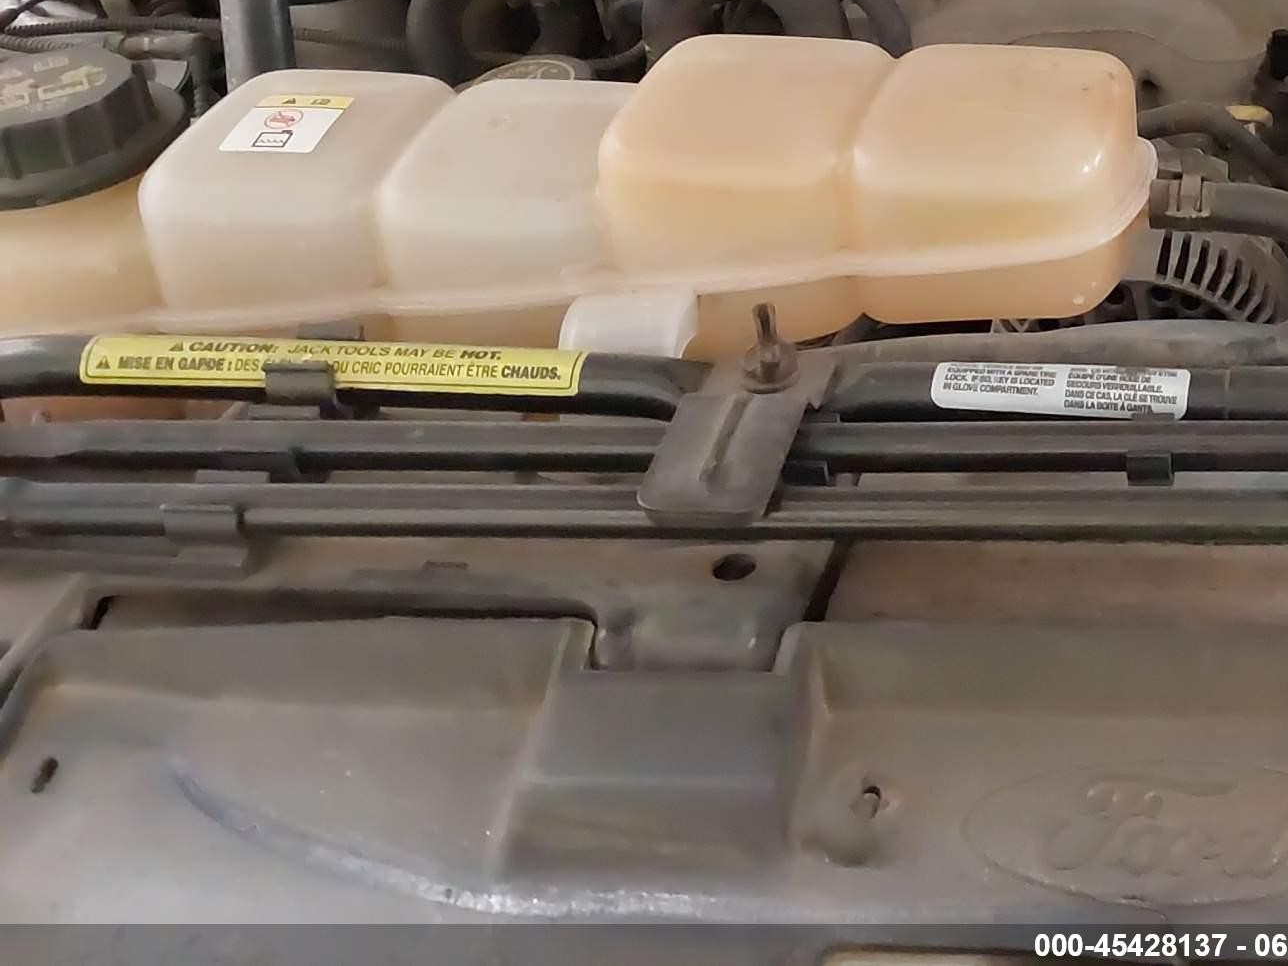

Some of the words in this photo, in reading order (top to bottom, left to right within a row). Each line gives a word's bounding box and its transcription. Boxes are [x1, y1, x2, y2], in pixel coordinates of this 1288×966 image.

[189, 341, 279, 353] CAUTION:
[288, 344, 331, 354] JACK
[337, 345, 391, 356] TOOLS
[394, 347, 428, 357] MAY
[432, 348, 454, 359] BE
[460, 349, 502, 360] HOT.
[118, 356, 152, 370] MISE
[156, 357, 173, 370] EN
[178, 357, 224, 371] GARDE
[235, 358, 258, 372] DES
[352, 362, 380, 375] CRIC
[384, 362, 464, 377] POURRAIENT
[501, 365, 561, 380] CHAUDS.
